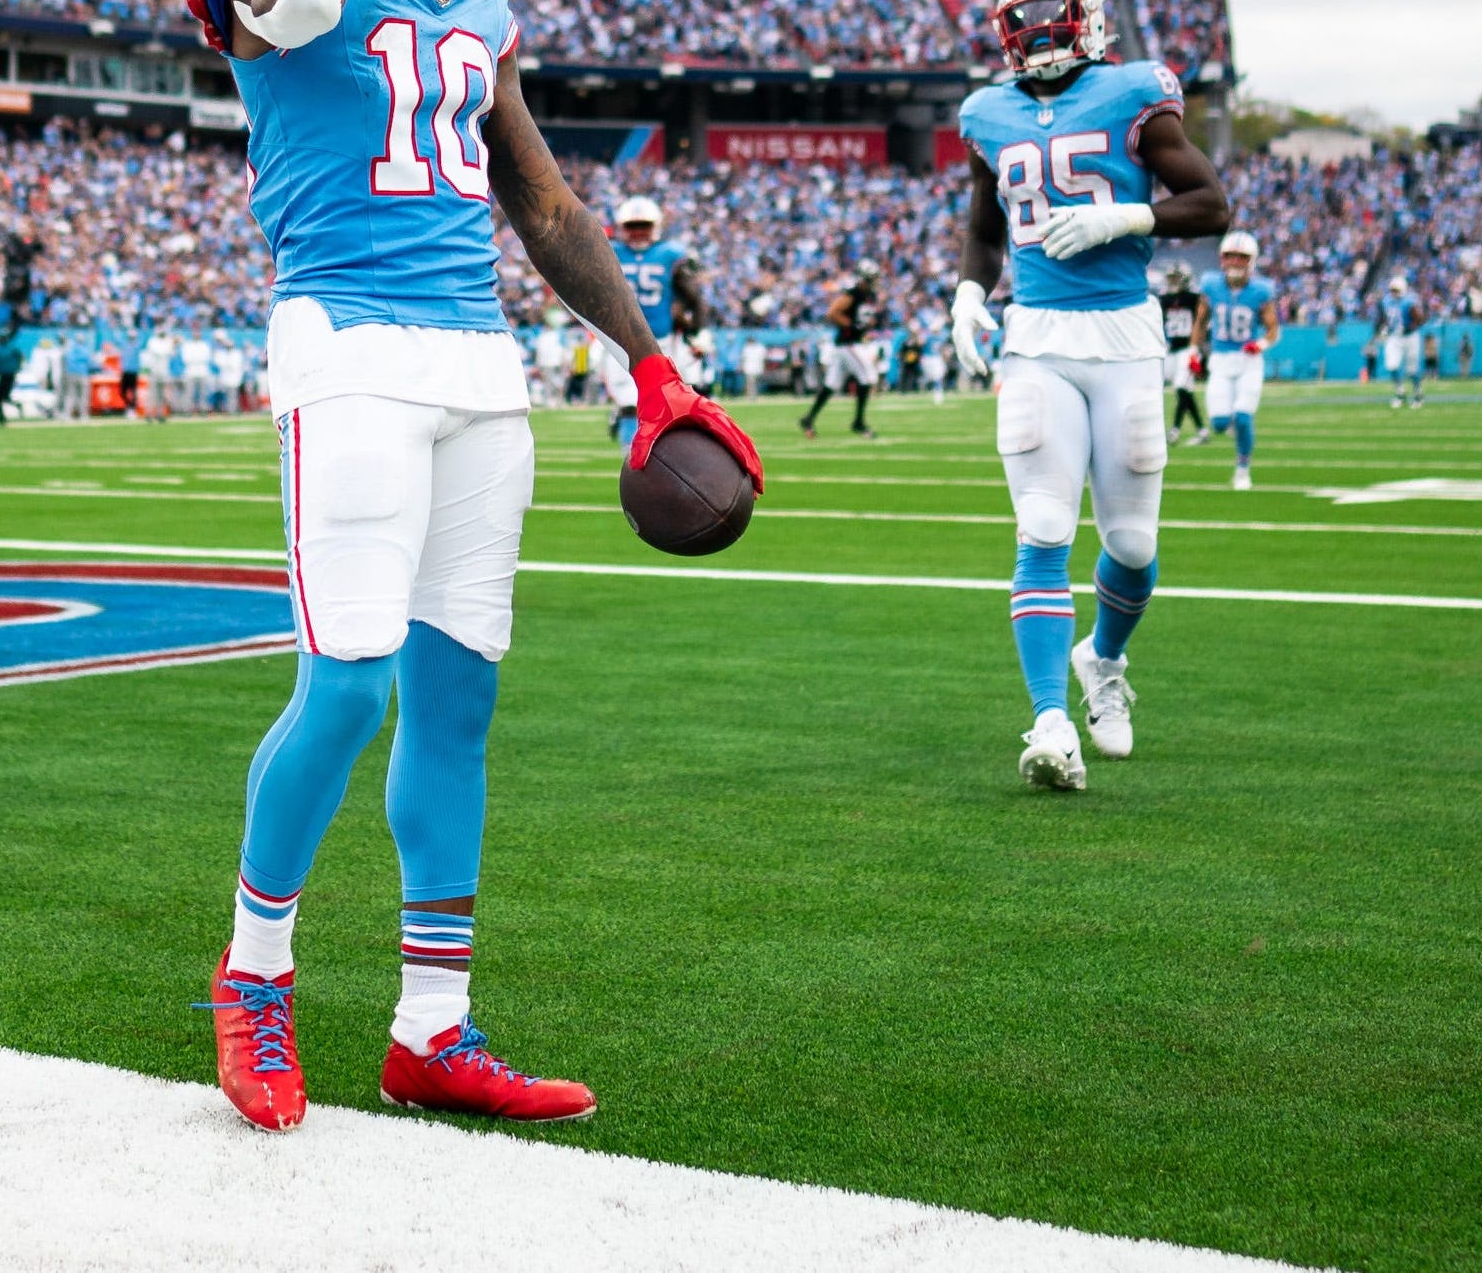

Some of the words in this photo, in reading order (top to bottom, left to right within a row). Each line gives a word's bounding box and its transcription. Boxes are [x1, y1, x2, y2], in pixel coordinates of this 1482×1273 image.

[367, 17, 495, 203] 10
[726, 134, 866, 160] NISSAN
[997, 131, 1115, 247] 85
[1214, 303, 1254, 343] 18
